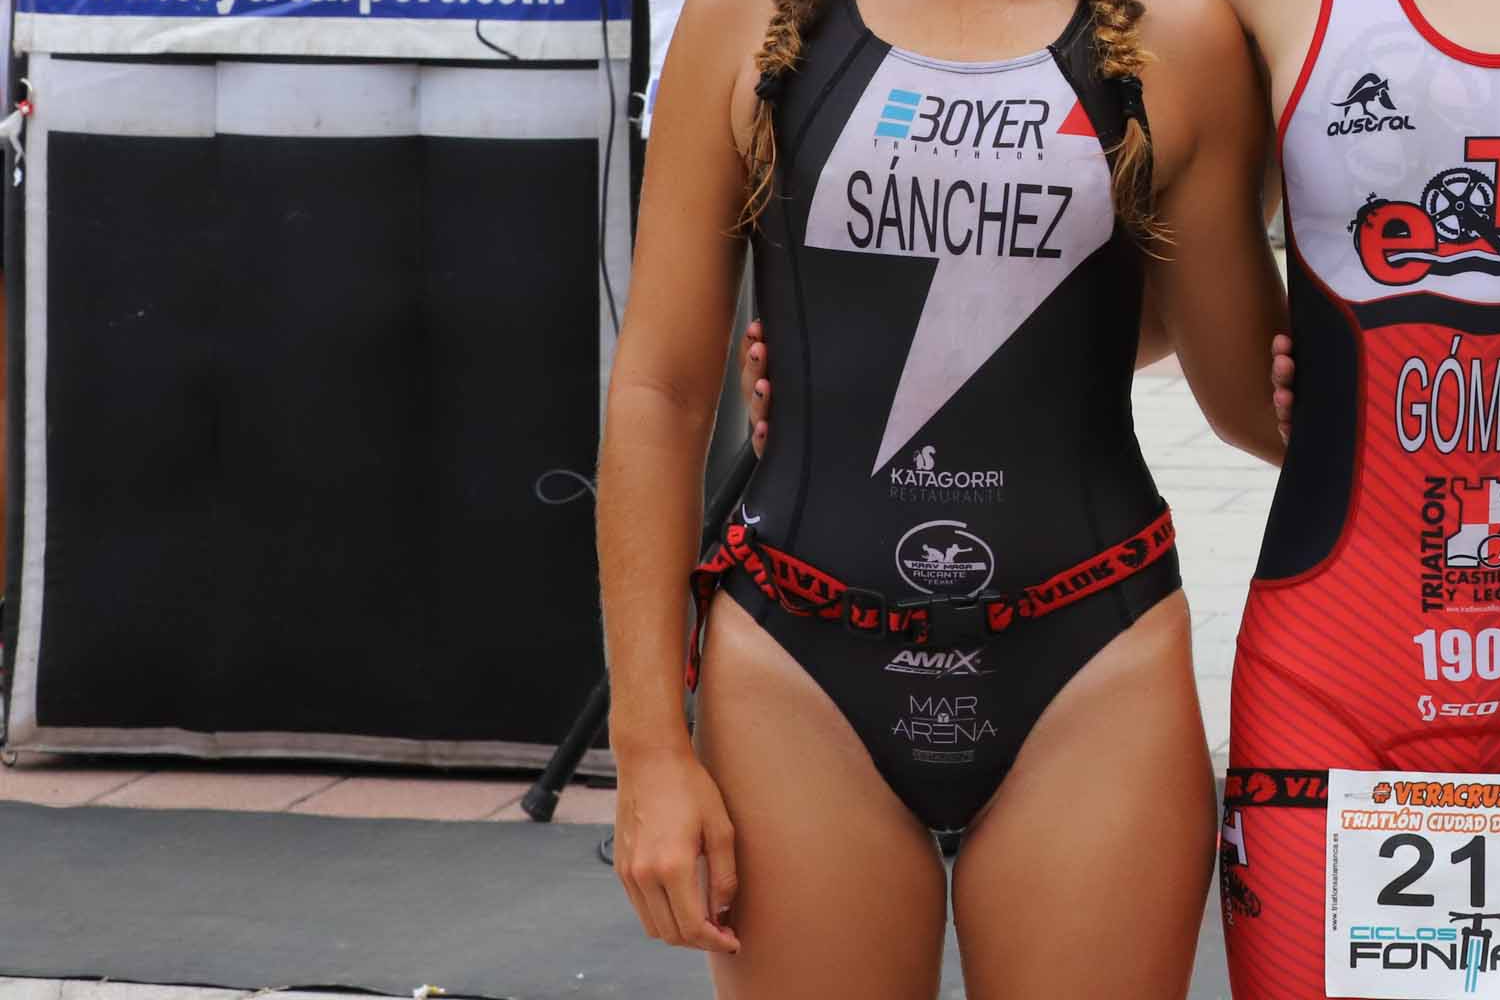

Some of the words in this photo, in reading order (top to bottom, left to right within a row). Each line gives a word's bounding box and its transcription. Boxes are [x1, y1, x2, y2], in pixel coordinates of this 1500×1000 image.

[910, 95, 1051, 150] BOYER
[873, 138, 1044, 161] TRIATHLON
[846, 156, 1073, 259] SÁNCHEZ
[890, 468, 1004, 488] KATAGORRI
[889, 487, 1005, 505] RESTAURANTE
[1421, 476, 1447, 613] TRIATLON
[1445, 588, 1457, 602] Y
[891, 649, 981, 673] AMIX
[909, 695, 978, 717] MAR
[891, 719, 999, 745] ARENA
[1341, 808, 1424, 832] TRIATLÓN
[1428, 811, 1487, 833] CIUDAD
[1350, 926, 1457, 941] CICLOS
